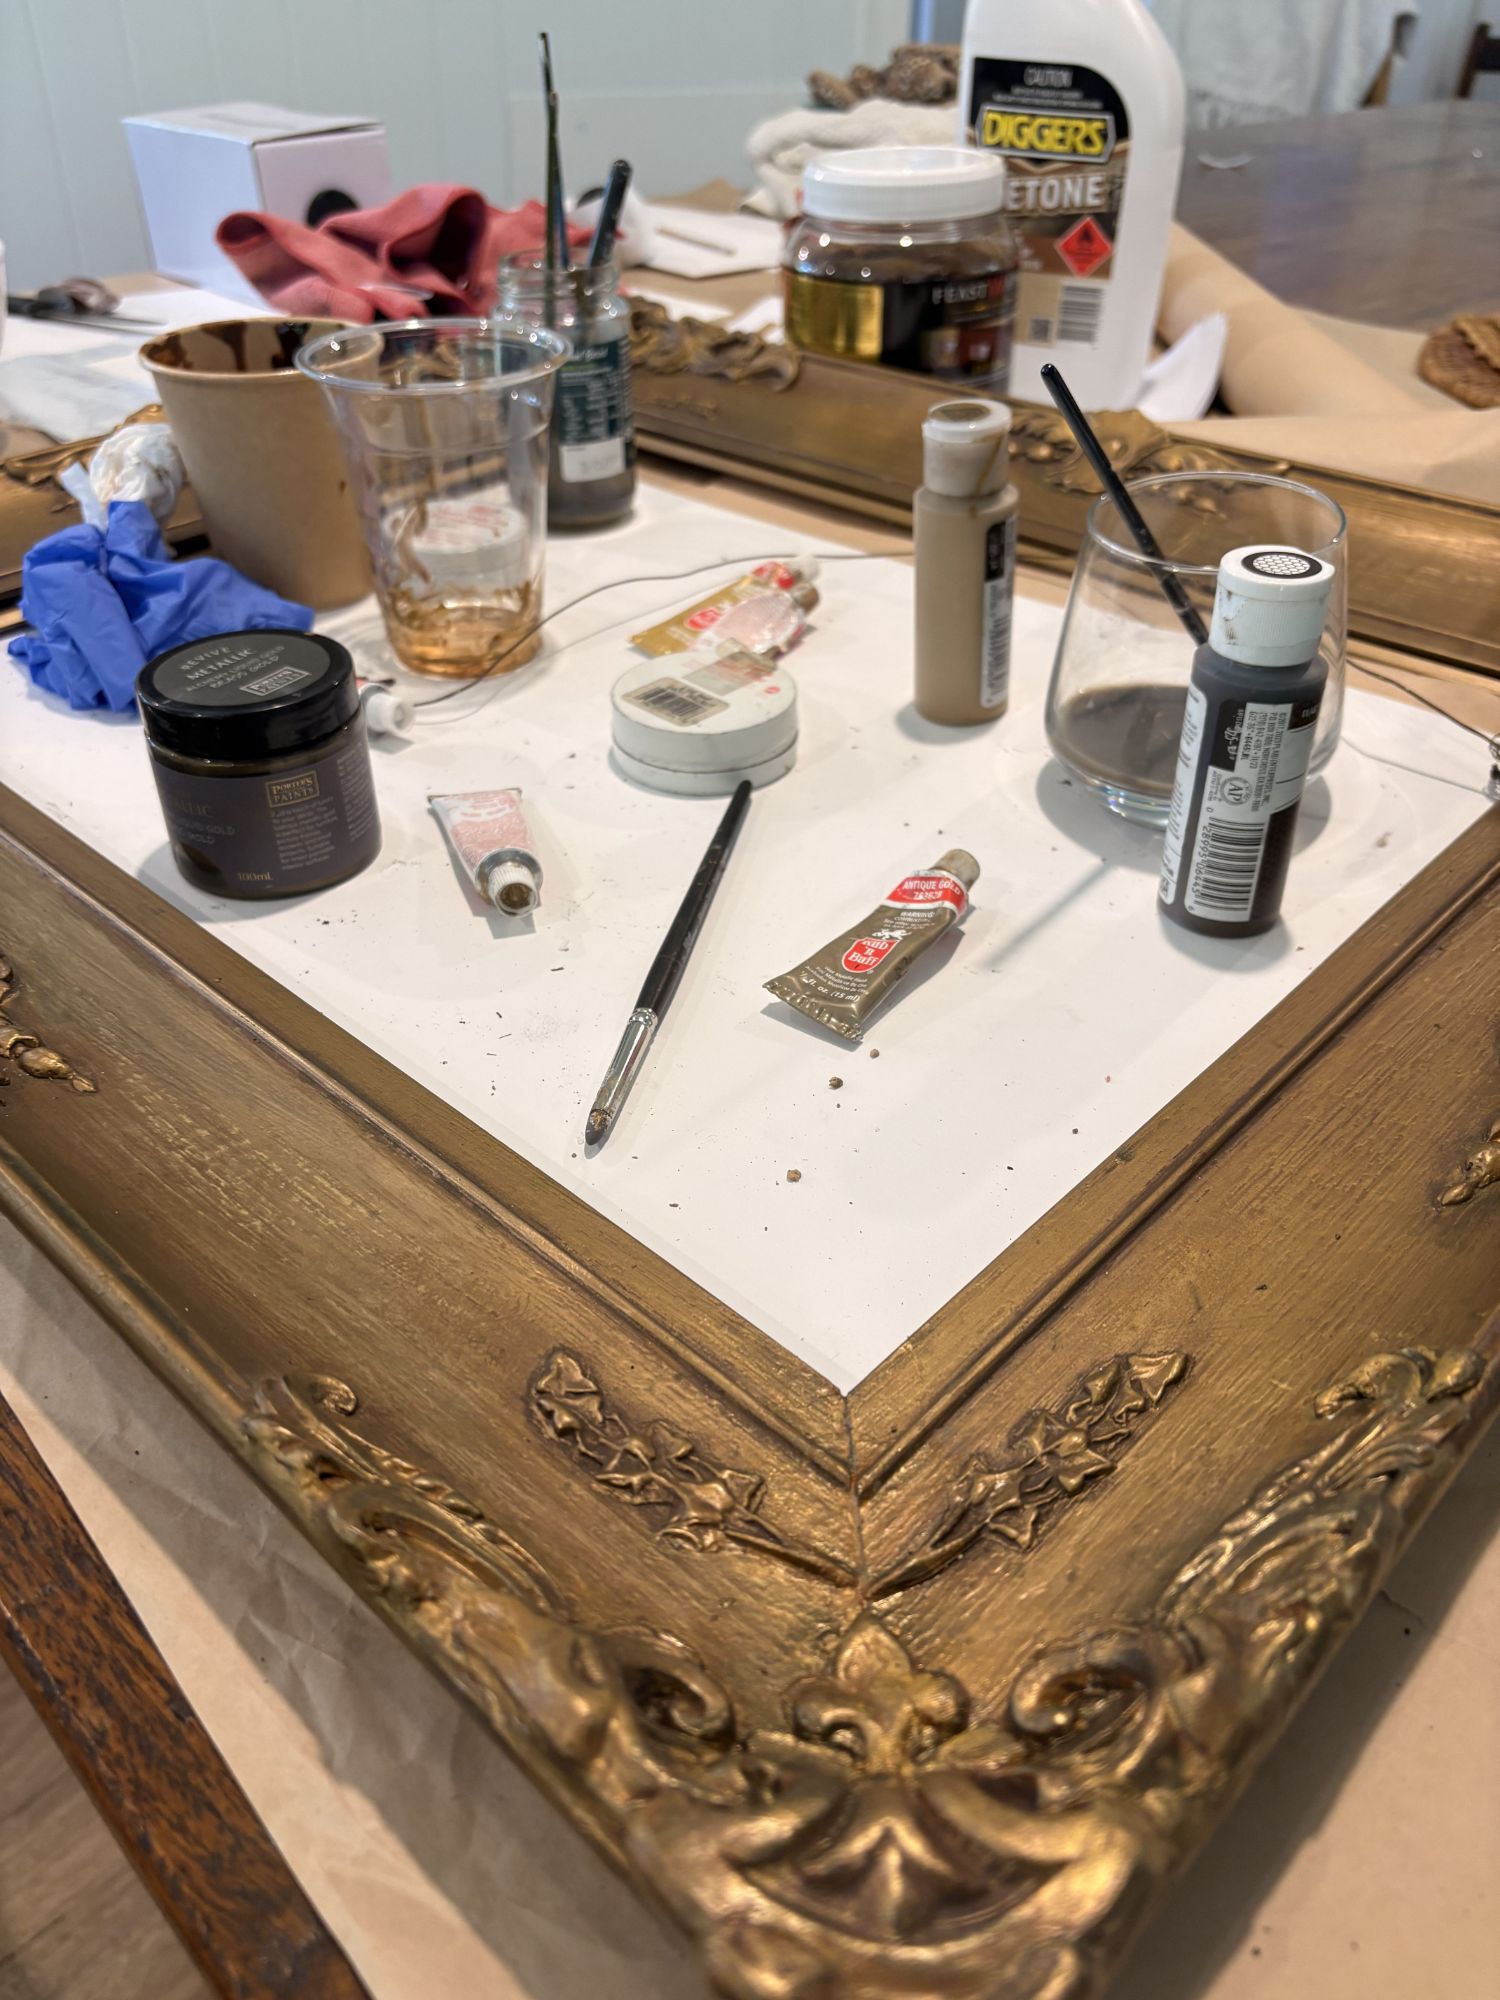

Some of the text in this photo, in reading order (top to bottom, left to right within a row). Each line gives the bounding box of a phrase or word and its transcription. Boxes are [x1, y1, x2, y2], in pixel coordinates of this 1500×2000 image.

[982, 111, 1107, 155] DIGGERS
[1006, 176, 1106, 211] ETONE
[180, 645, 231, 671] REVIVE
[186, 648, 257, 681] METALLIC
[273, 787, 314, 803] PAINTS
[1228, 783, 1244, 801] AP
[1198, 825, 1212, 859] 28995
[903, 878, 961, 895] ANTIQUE GOLD
[1192, 862, 1204, 893] 06445
[861, 939, 889, 950] Rub
[848, 951, 879, 966] Buff
